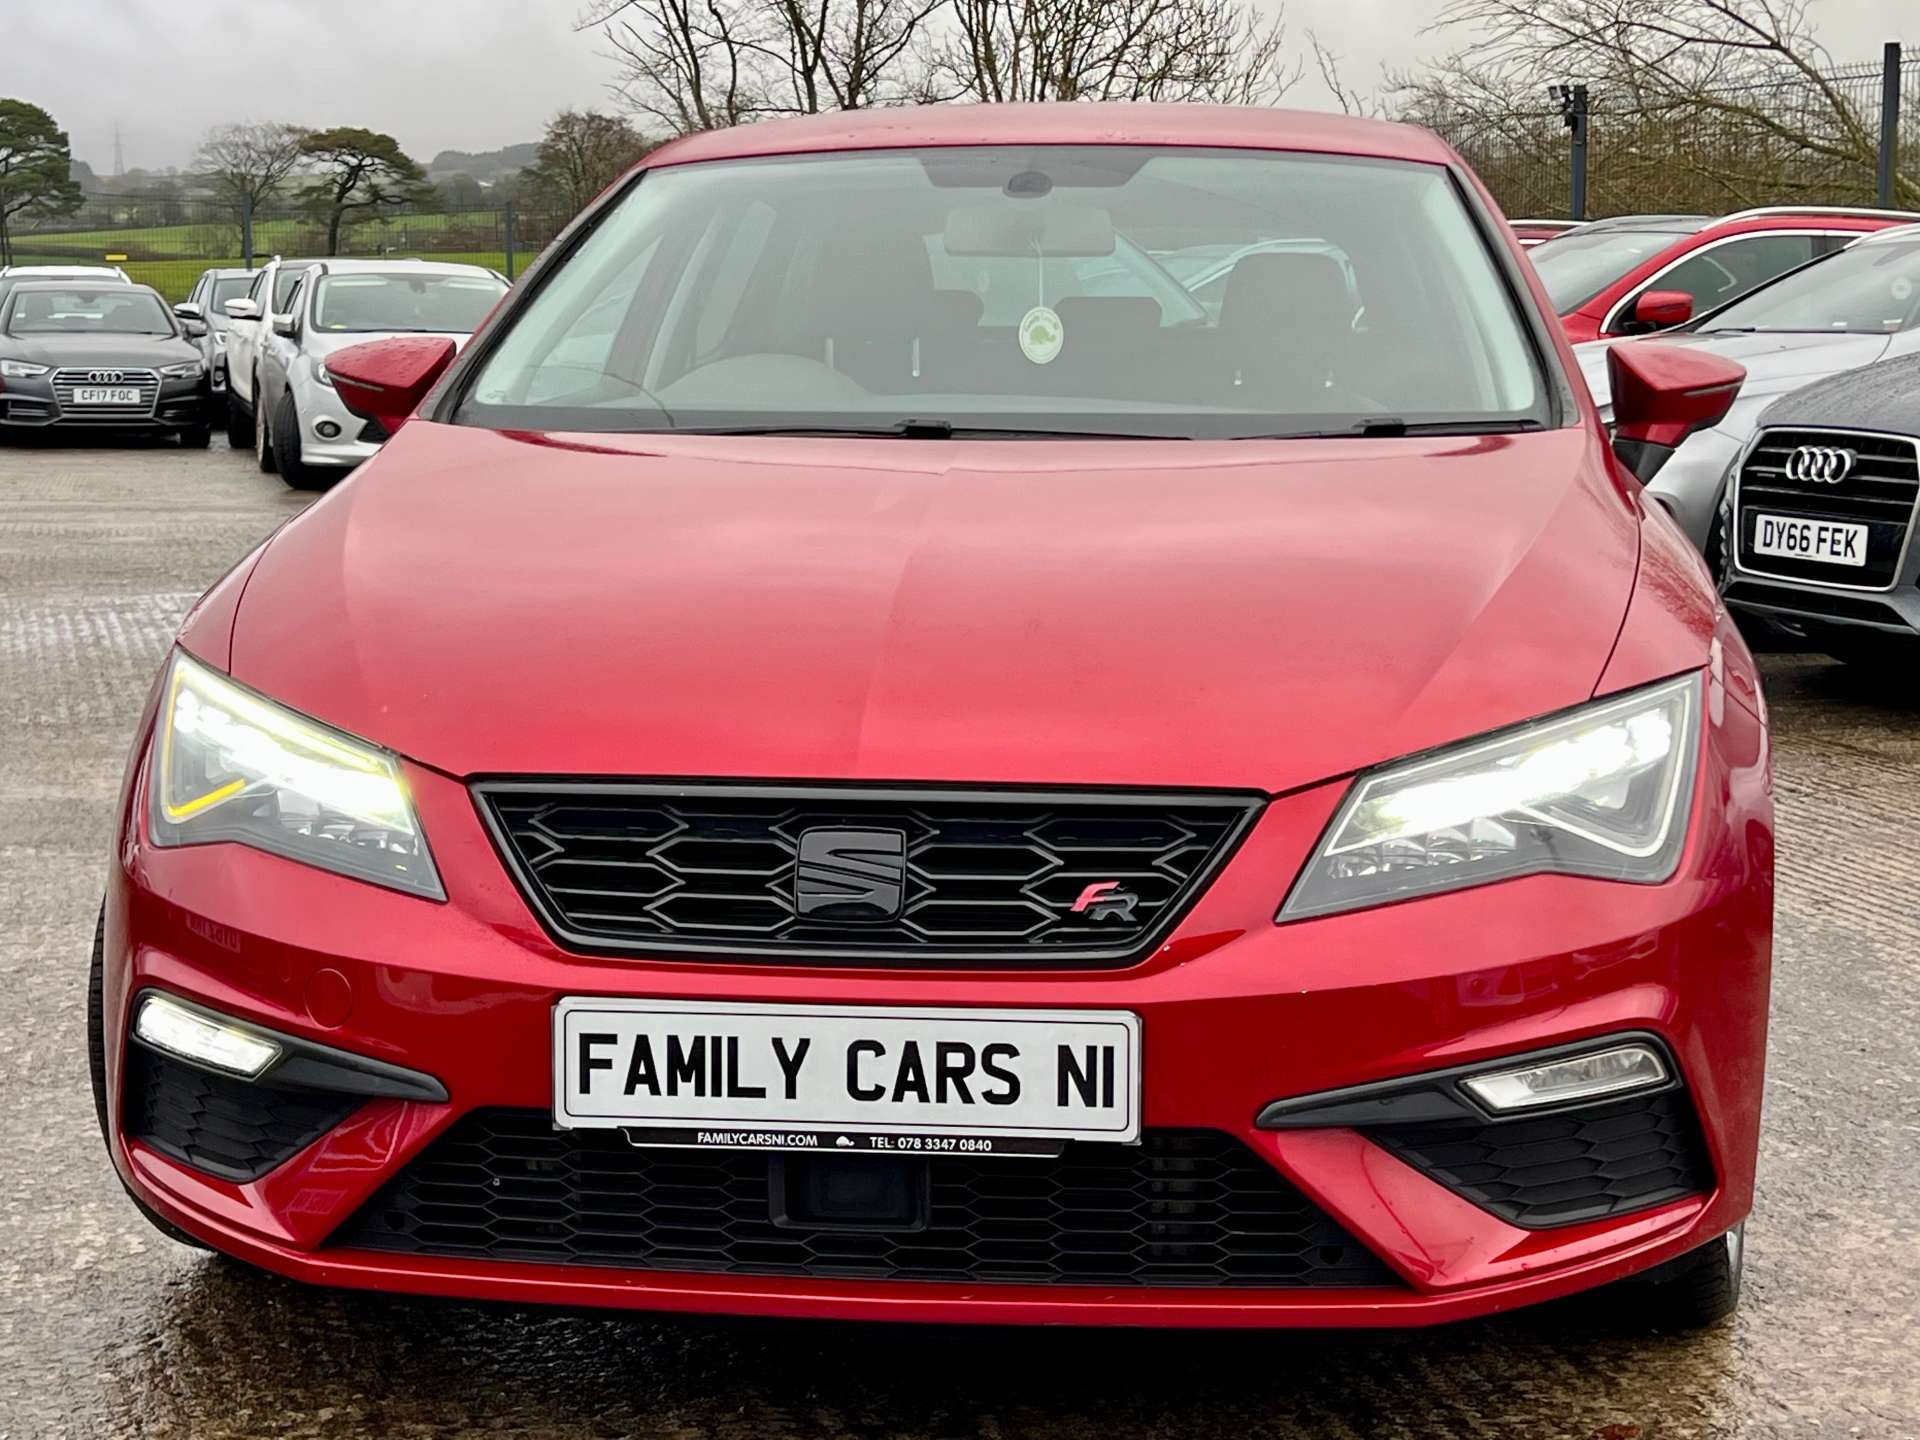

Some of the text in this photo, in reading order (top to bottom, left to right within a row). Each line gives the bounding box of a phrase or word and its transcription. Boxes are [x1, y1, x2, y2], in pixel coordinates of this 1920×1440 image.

[1763, 520, 1858, 558] DY66 FEK
[579, 1033, 1115, 1108] FAMILY CARS NI
[697, 1132, 818, 1147] FAMILYCARSNI.COM
[897, 1137, 922, 1149] 078
[924, 1138, 956, 1151] 3347
[959, 1139, 992, 1152] 0840
